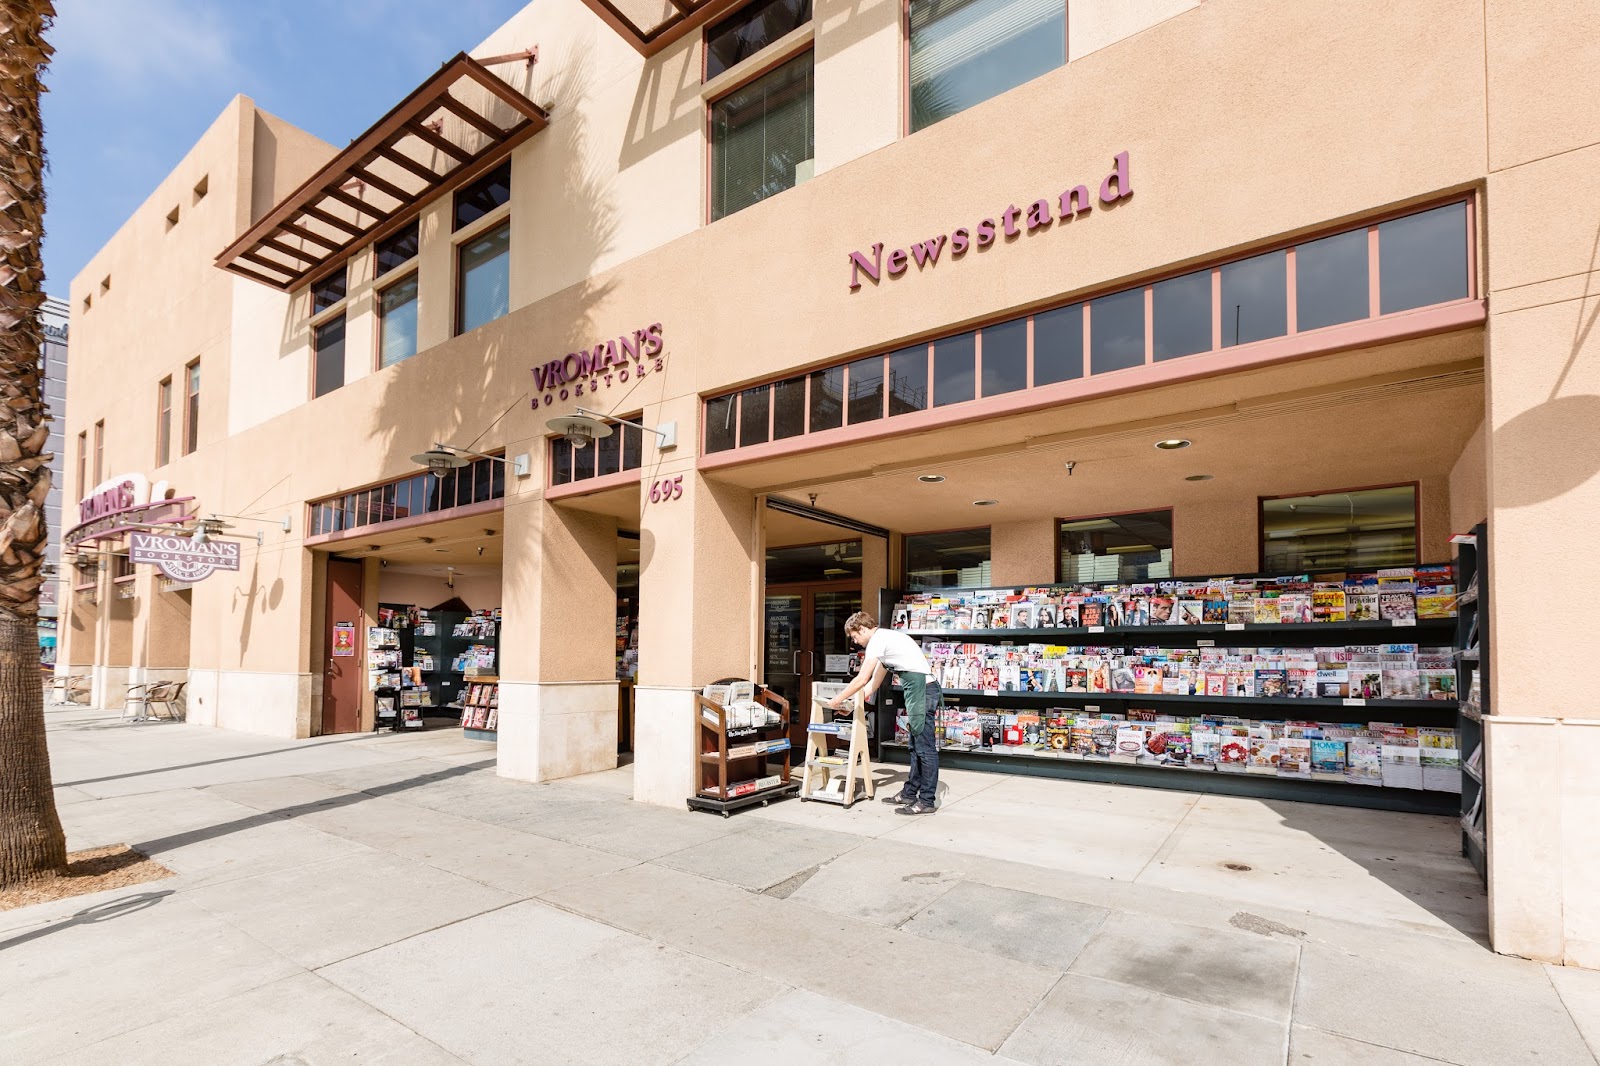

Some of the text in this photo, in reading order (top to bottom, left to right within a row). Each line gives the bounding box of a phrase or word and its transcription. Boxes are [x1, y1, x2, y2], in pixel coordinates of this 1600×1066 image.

[849, 150, 1134, 290] Newsstand
[530, 322, 664, 393] VROMAN'S
[531, 357, 664, 410] BOOKSTORE
[650, 474, 684, 504] 695
[134, 534, 239, 557] VROMAN'S
[135, 550, 238, 566] BOOKSTORE
[1159, 580, 1184, 589] GOLF
[1344, 584, 1378, 594] travel
[1153, 662, 1178, 670] SHPE
[1313, 741, 1345, 750] HOMES
